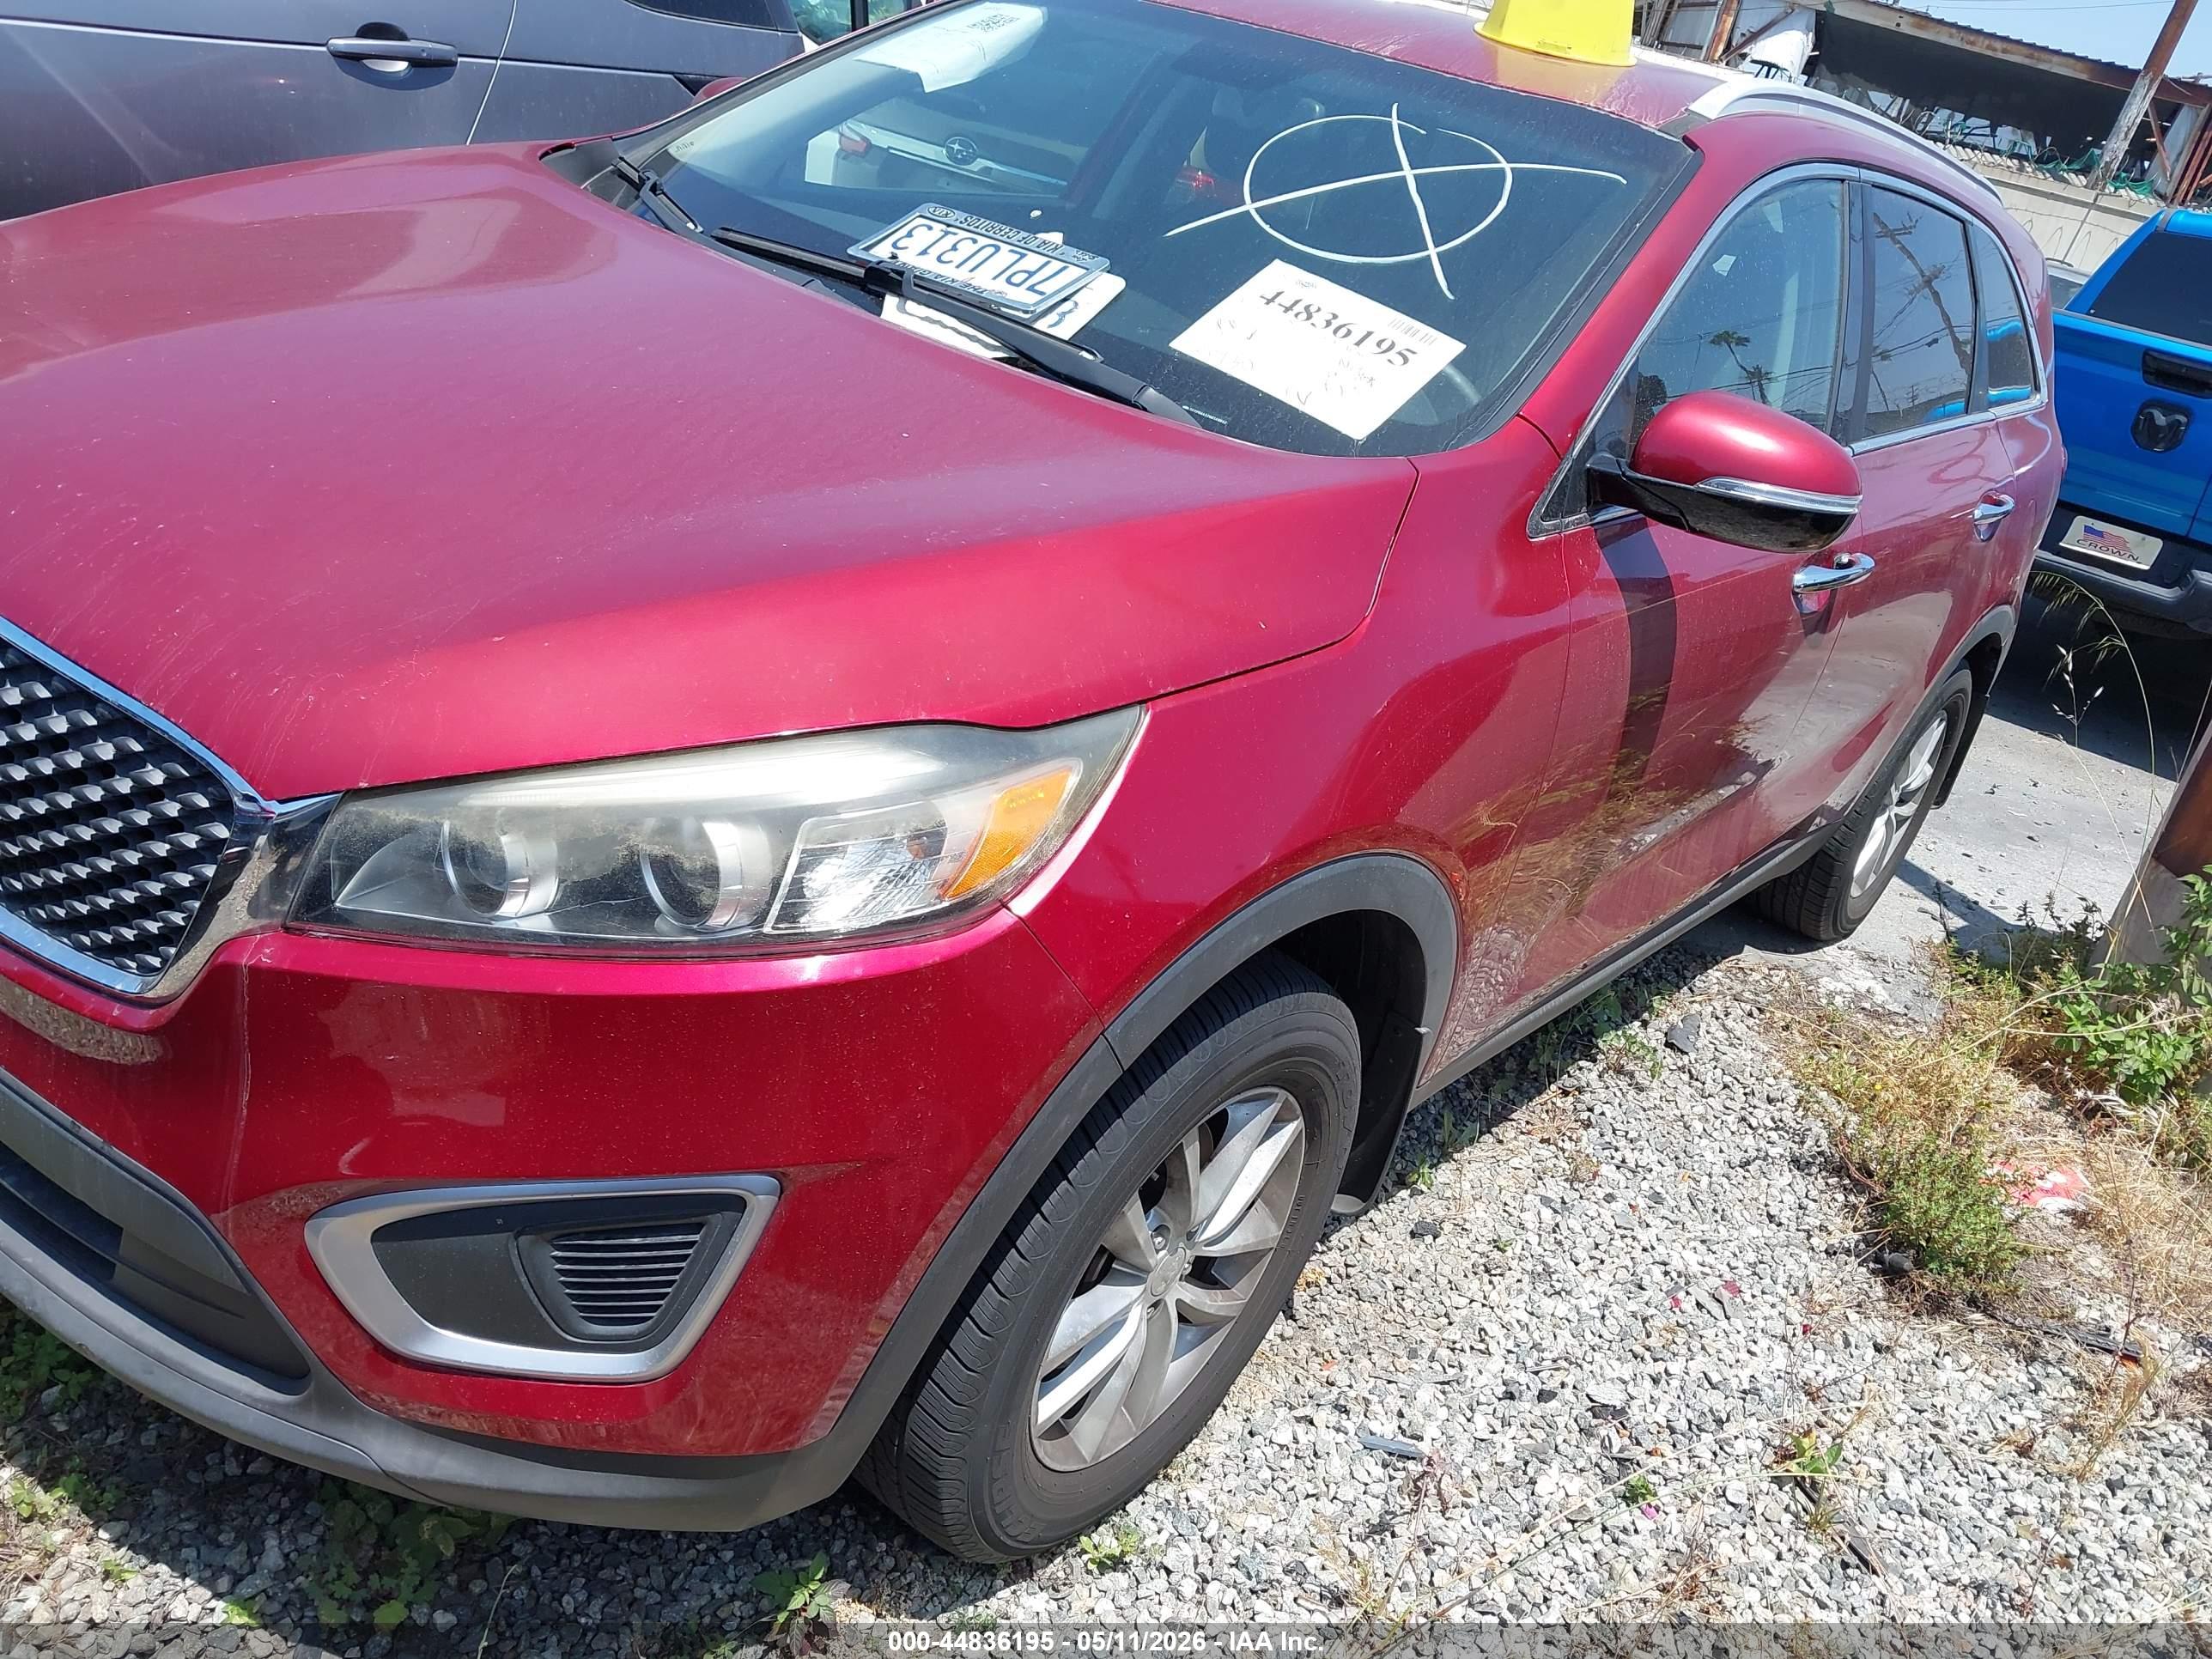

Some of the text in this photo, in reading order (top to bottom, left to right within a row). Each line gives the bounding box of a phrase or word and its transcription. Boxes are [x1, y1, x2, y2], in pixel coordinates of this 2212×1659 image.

[959, 215, 1064, 253] KIA OF CERRITOS
[890, 223, 1069, 296] 7PLU313
[934, 274, 958, 285] KIA
[959, 281, 988, 295] THE
[1260, 291, 1418, 366] 44836195
[2076, 538, 2140, 561] CROWN
